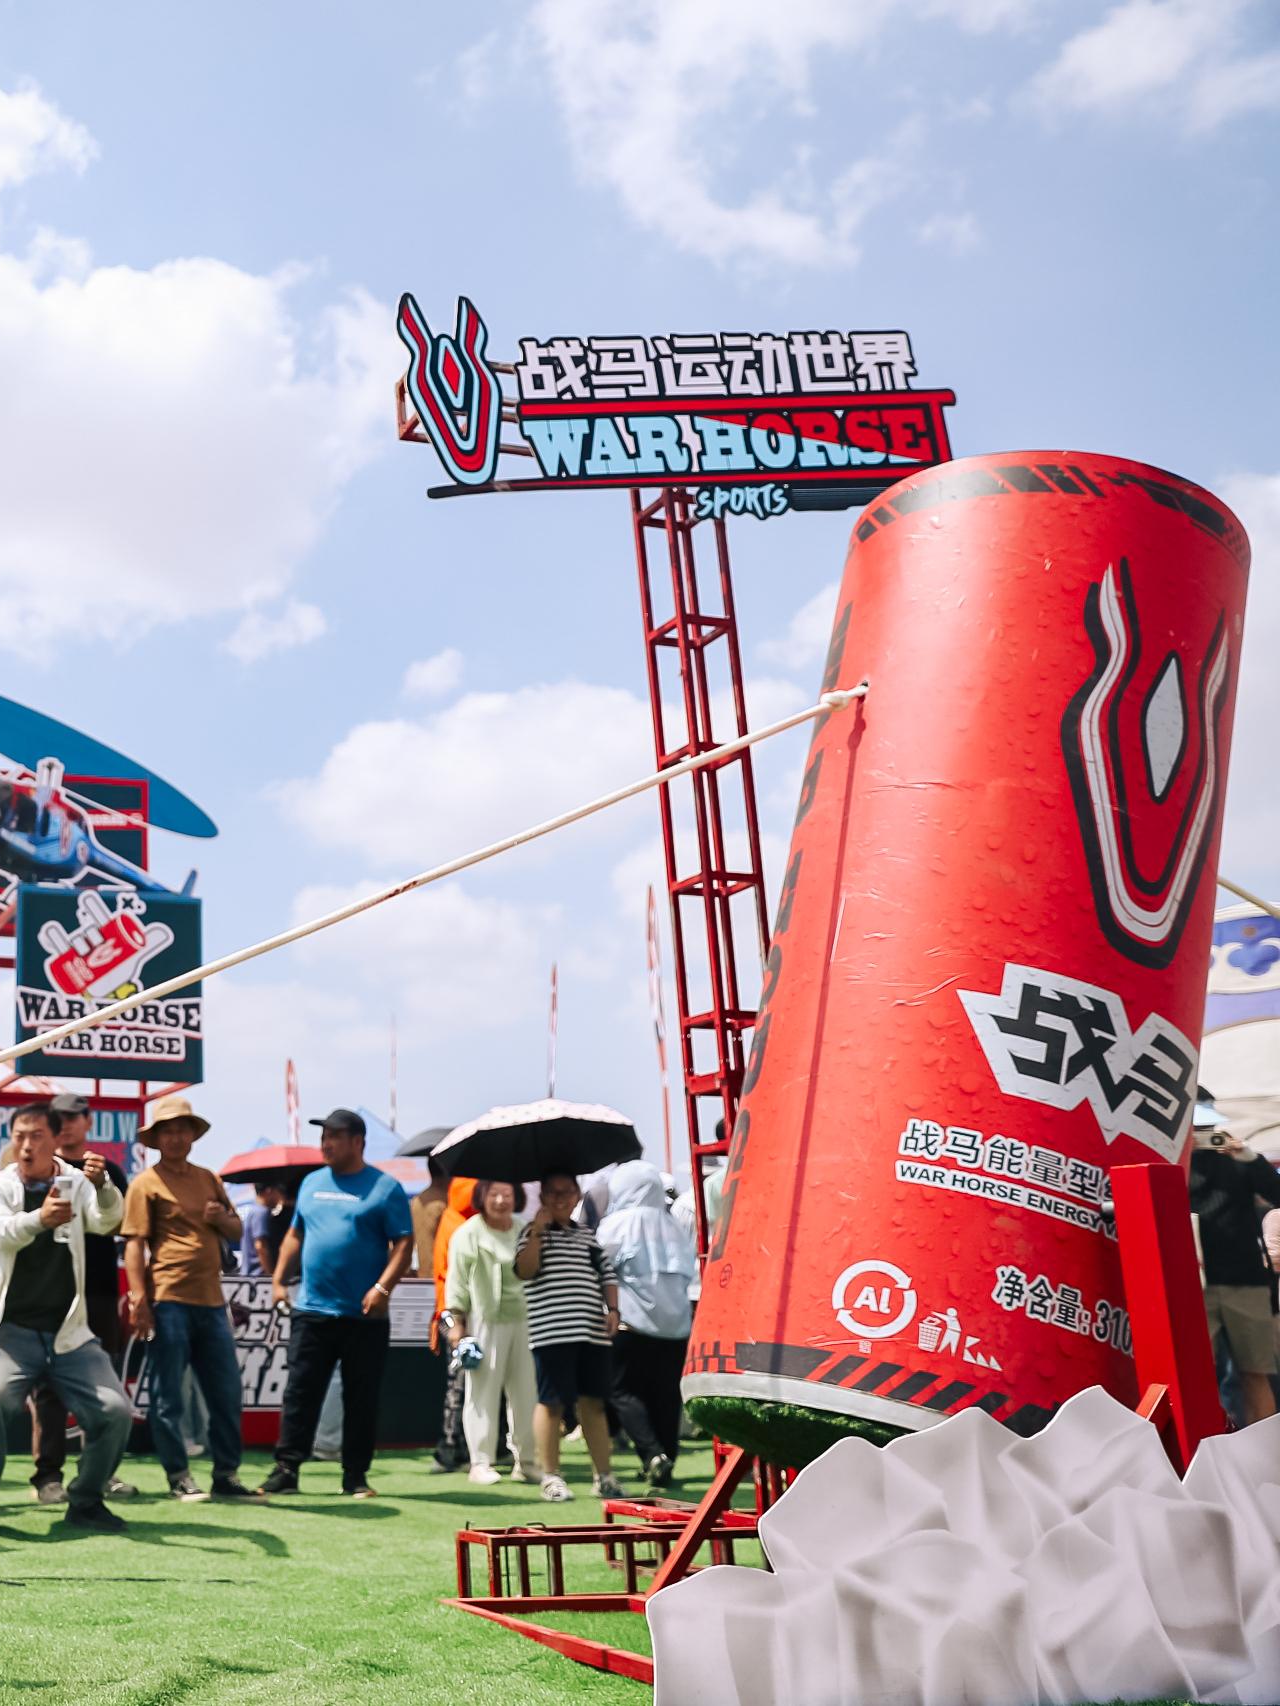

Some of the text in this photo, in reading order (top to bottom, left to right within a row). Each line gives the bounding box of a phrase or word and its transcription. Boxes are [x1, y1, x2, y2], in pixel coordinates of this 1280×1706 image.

[520, 331, 916, 399] 战马运动世界
[523, 406, 931, 477] WAR HORSE
[697, 483, 789, 518] SPORTS
[20, 991, 87, 1021] WAR
[100, 1034, 181, 1055] HORSE
[992, 983, 1198, 1141] 战马
[904, 1121, 1112, 1202] 战马能量型
[900, 1164, 1102, 1228] WAR HORSE ENERGY
